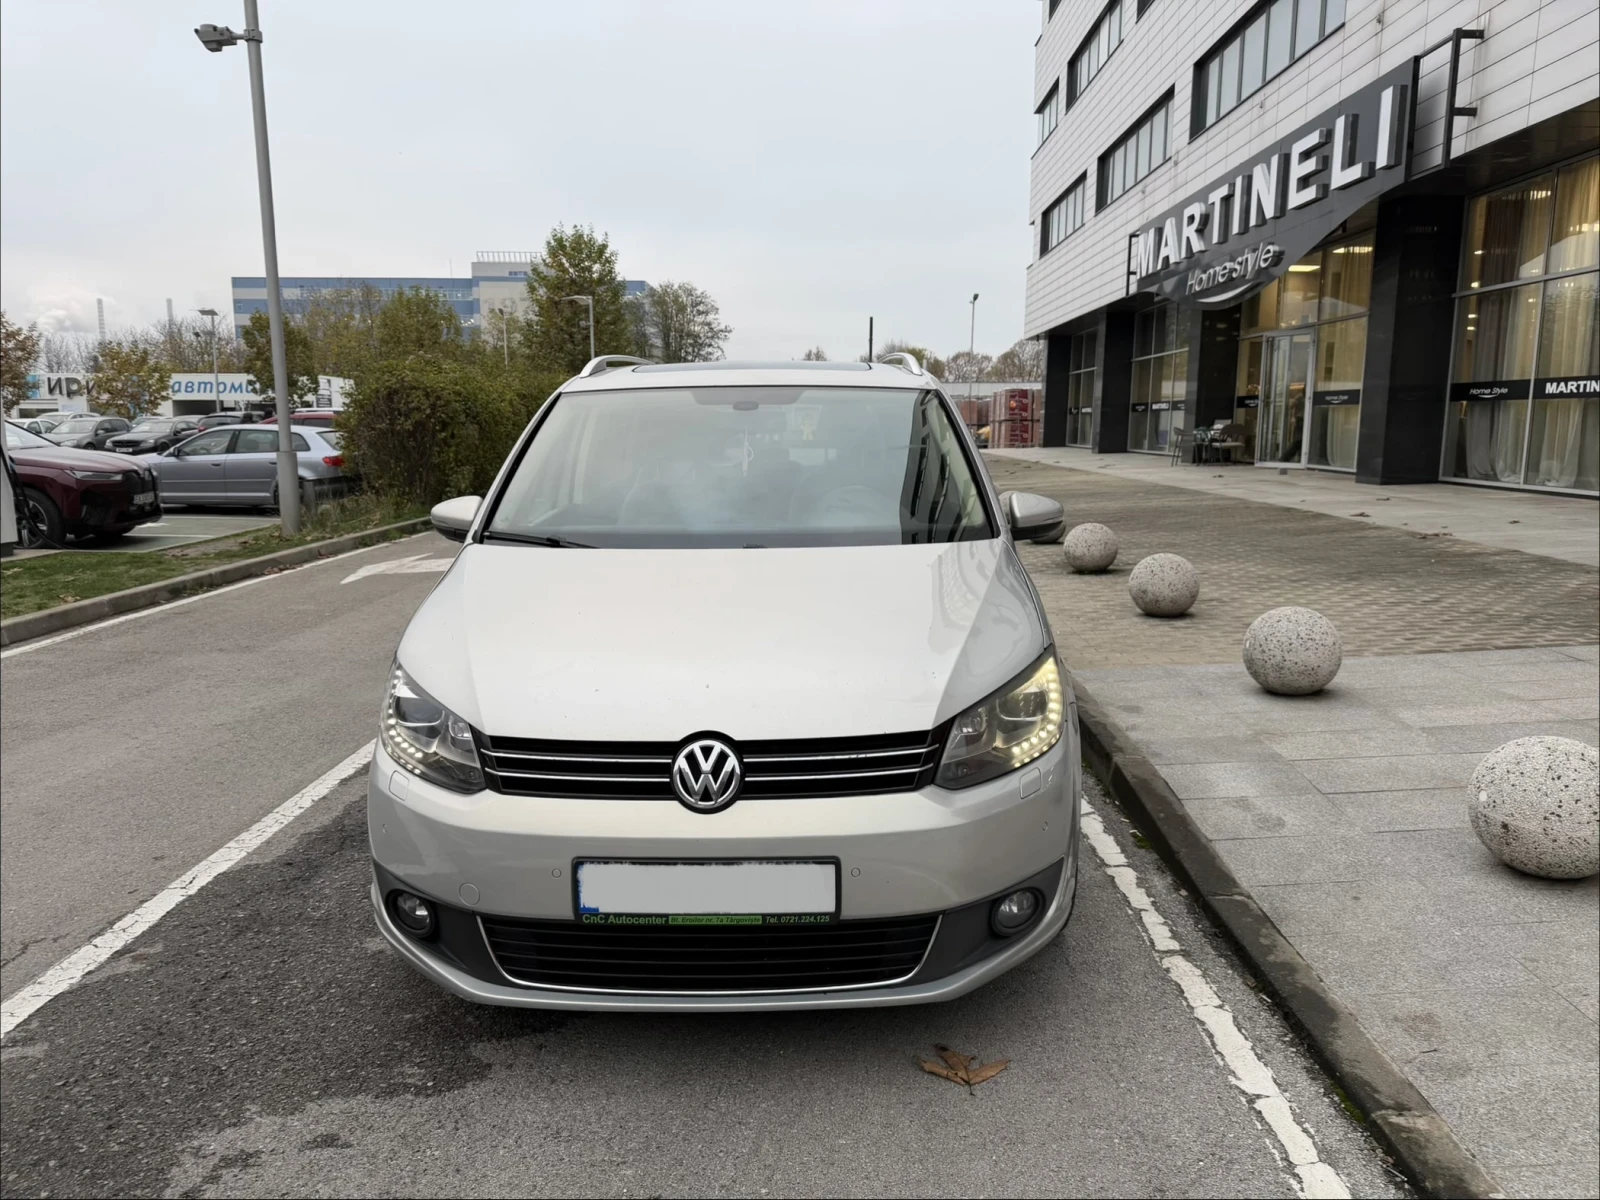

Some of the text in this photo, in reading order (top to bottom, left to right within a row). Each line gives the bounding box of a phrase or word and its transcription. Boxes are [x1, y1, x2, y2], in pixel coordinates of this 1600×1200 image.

[1137, 84, 1403, 280] MARTINELI
[1185, 261, 1233, 295] Home
[1491, 387, 1508, 397] Style
[1545, 380, 1600, 394] MARTIN
[582, 914, 667, 925] CnC Autocenter
[780, 915, 830, 923] 0721.224.125
